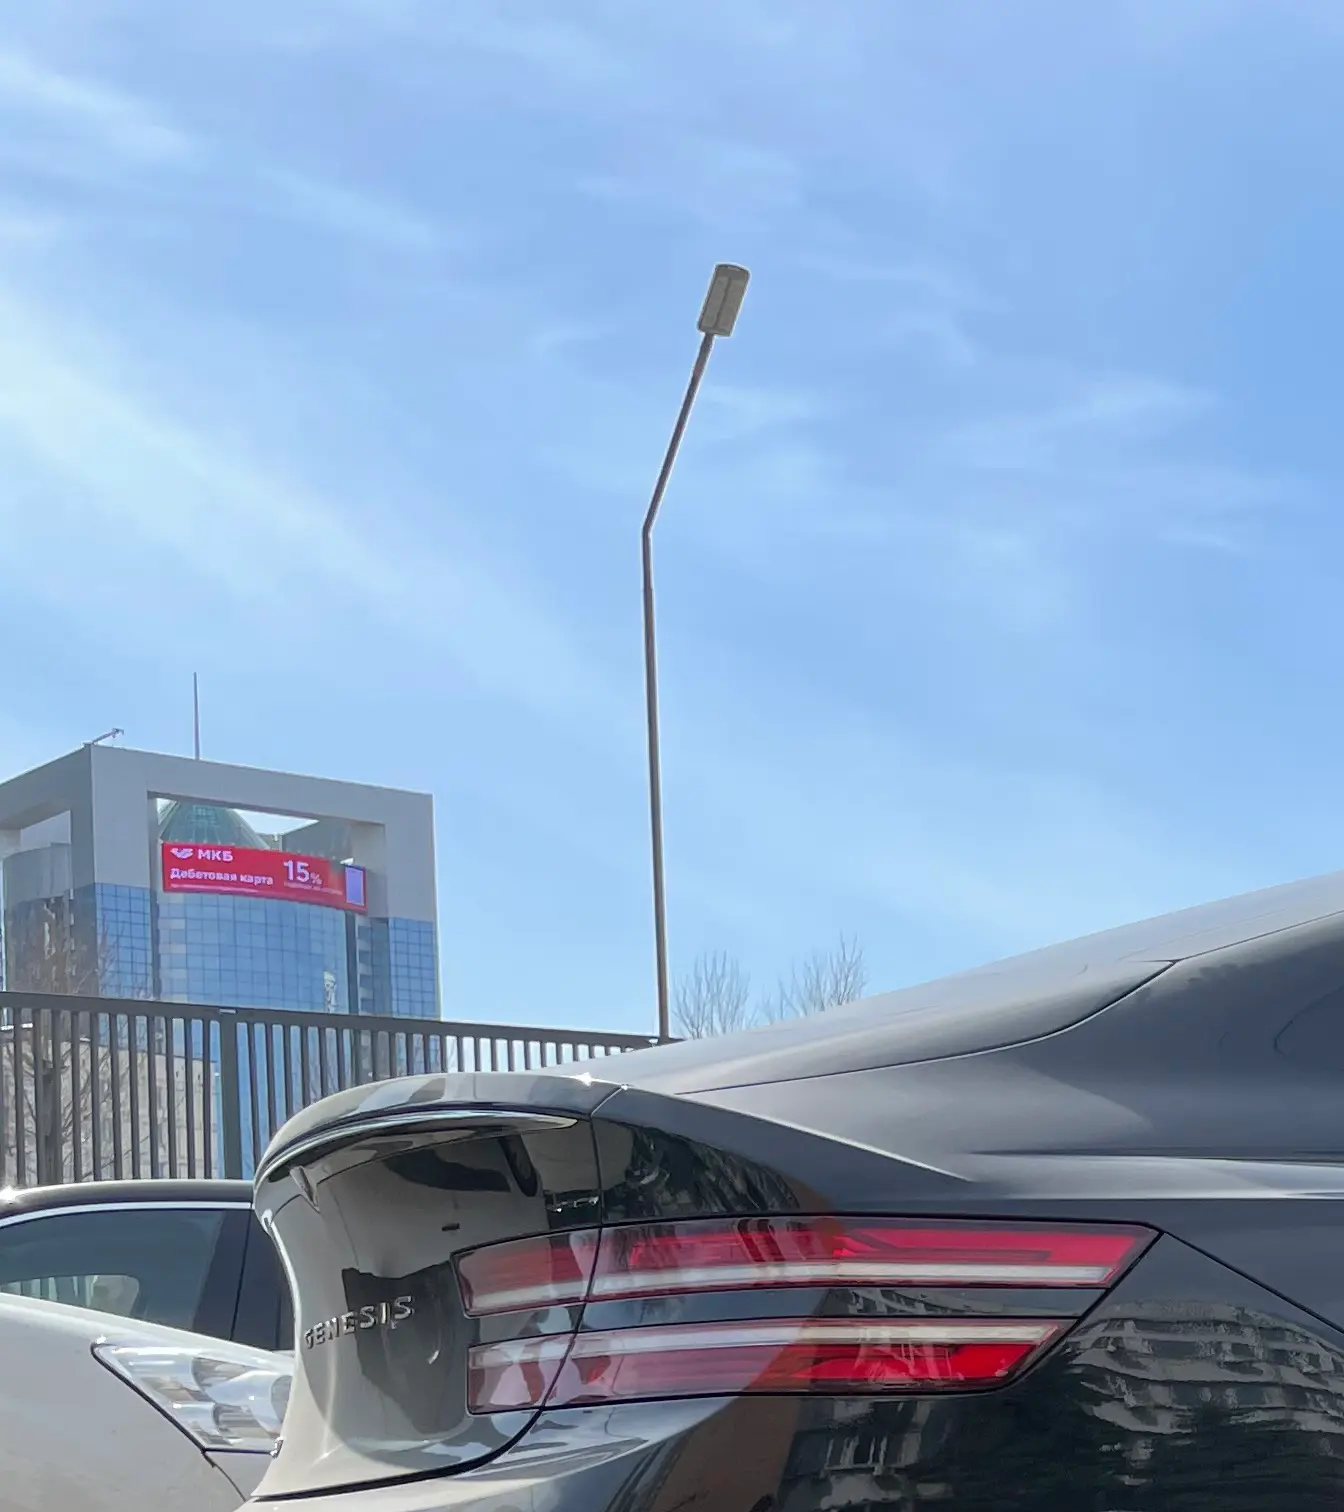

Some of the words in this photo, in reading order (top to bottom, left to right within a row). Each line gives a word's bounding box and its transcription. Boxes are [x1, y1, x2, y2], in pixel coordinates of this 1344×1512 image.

[197, 849, 234, 862] МКБ
[170, 867, 237, 883] Дебетовая
[240, 873, 274, 886] карта
[304, 1295, 413, 1350] GENESIS
